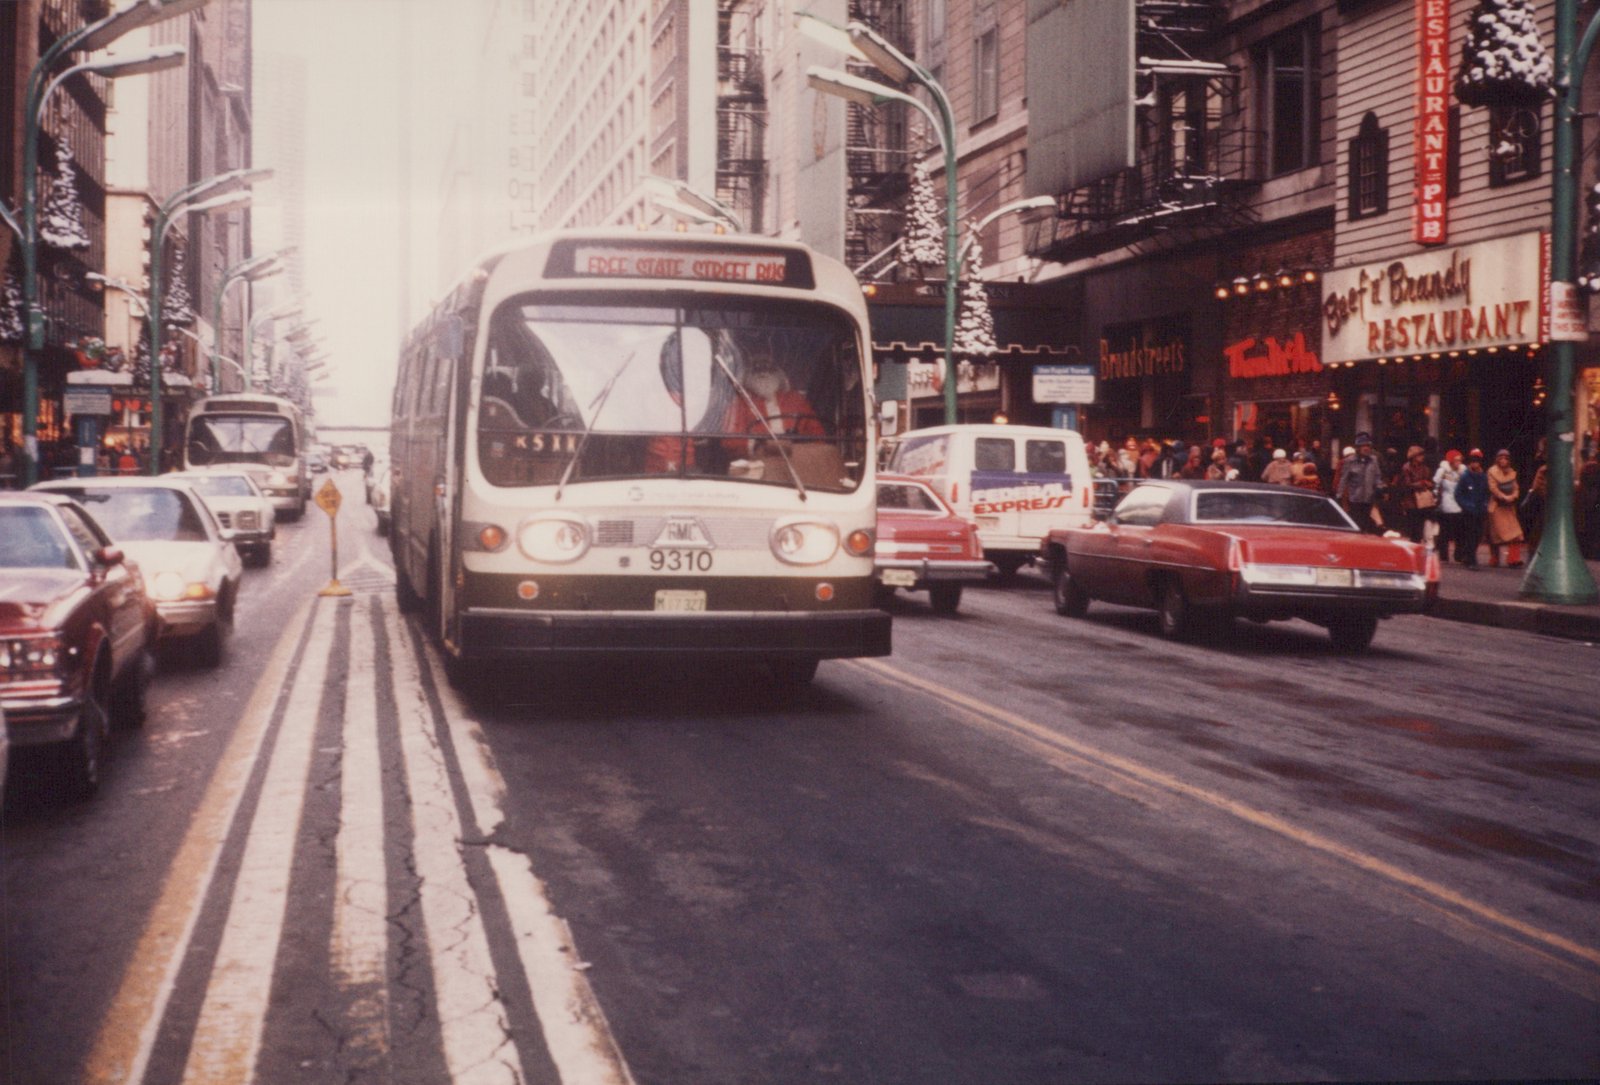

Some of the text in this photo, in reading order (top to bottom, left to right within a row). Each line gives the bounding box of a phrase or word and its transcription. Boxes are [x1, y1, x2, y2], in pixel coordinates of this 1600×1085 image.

[1424, 0, 1445, 170] ESTAURANT
[588, 255, 786, 282] FREE STATE STREET BUS
[1324, 268, 1369, 338] Beef
[1387, 249, 1471, 306] Brandy
[1367, 300, 1531, 353] RESTAURANT
[973, 496, 1073, 514] EXPRESS
[649, 550, 714, 572] 9310
